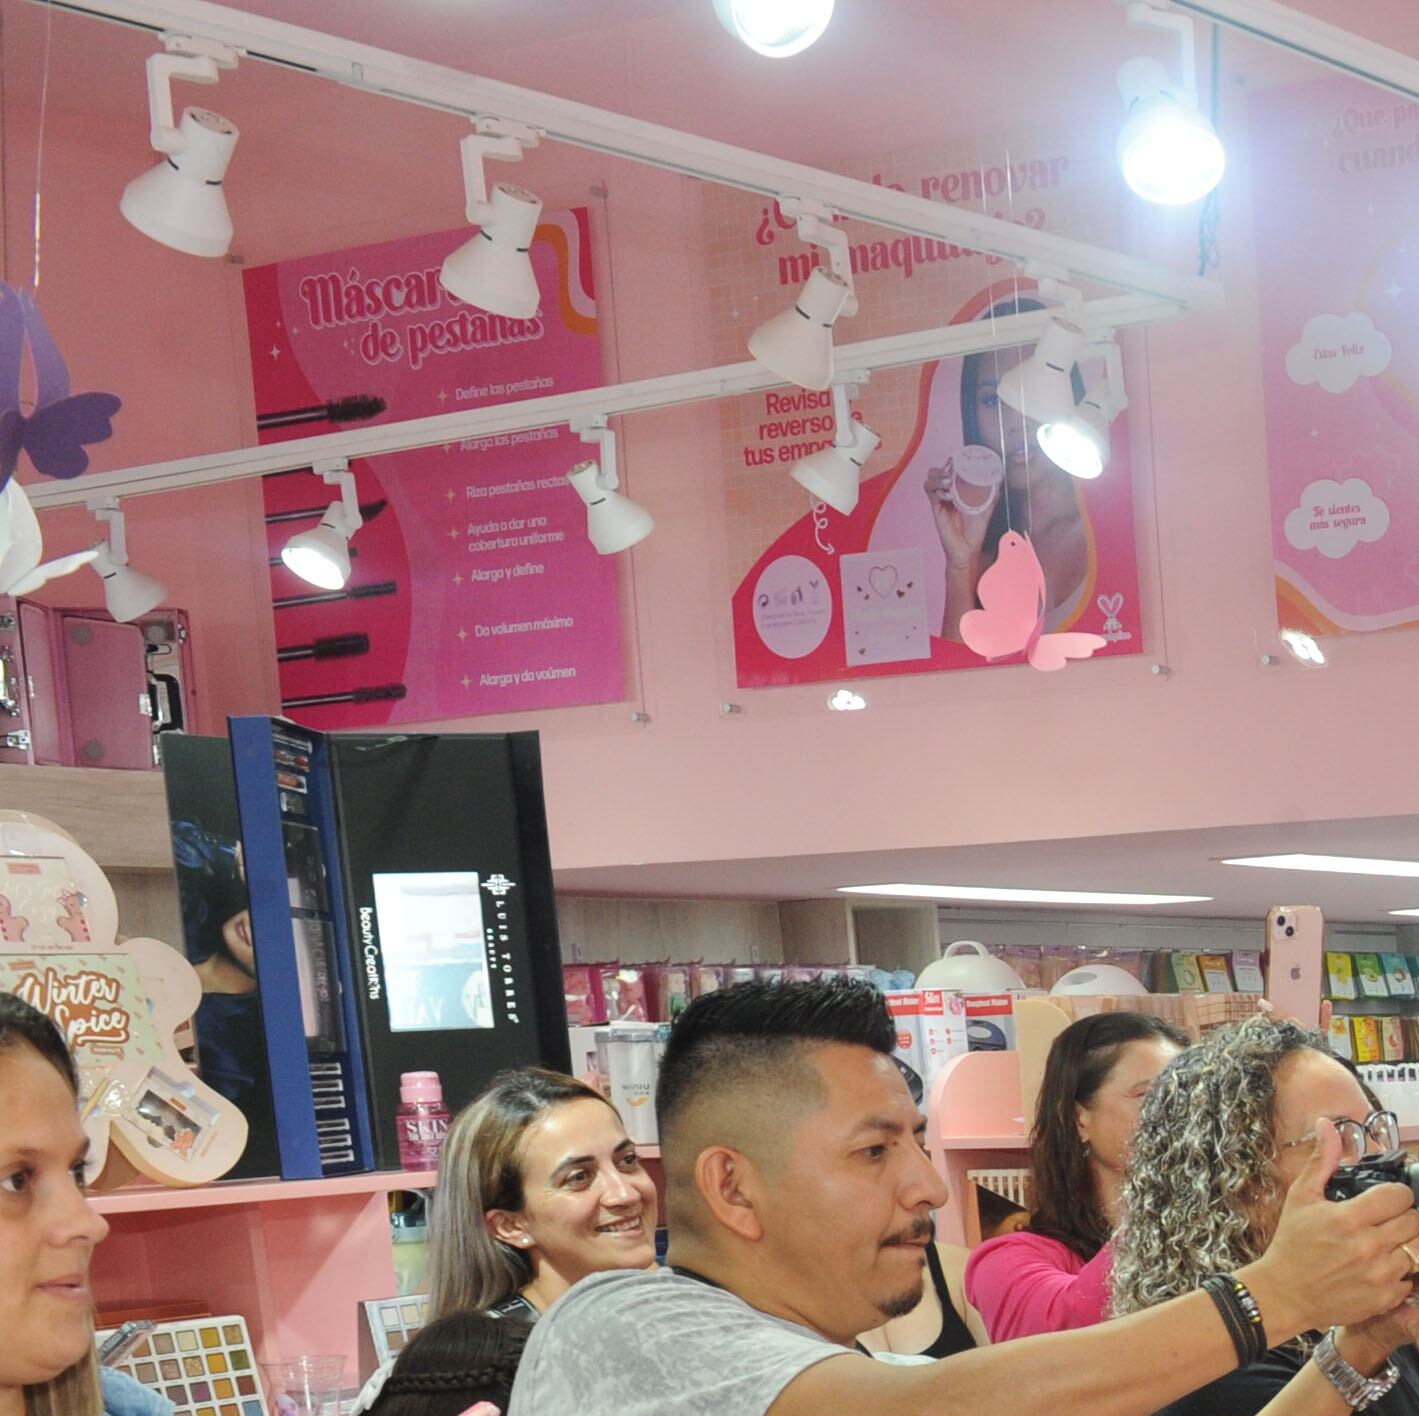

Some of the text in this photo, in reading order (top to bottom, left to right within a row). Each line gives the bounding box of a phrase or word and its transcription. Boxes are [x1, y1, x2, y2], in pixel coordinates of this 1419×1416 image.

[920, 155, 1070, 202] renovar
[300, 267, 464, 329] Máscar
[360, 320, 402, 366] de
[456, 385, 489, 401] Define
[766, 388, 831, 416] Revisa
[758, 414, 834, 441] reverso
[743, 445, 775, 467] tus
[491, 619, 533, 635] volumen
[14, 968, 120, 1016] Winter
[51, 1002, 129, 1046] Spice
[405, 1119, 449, 1135] SKIN
